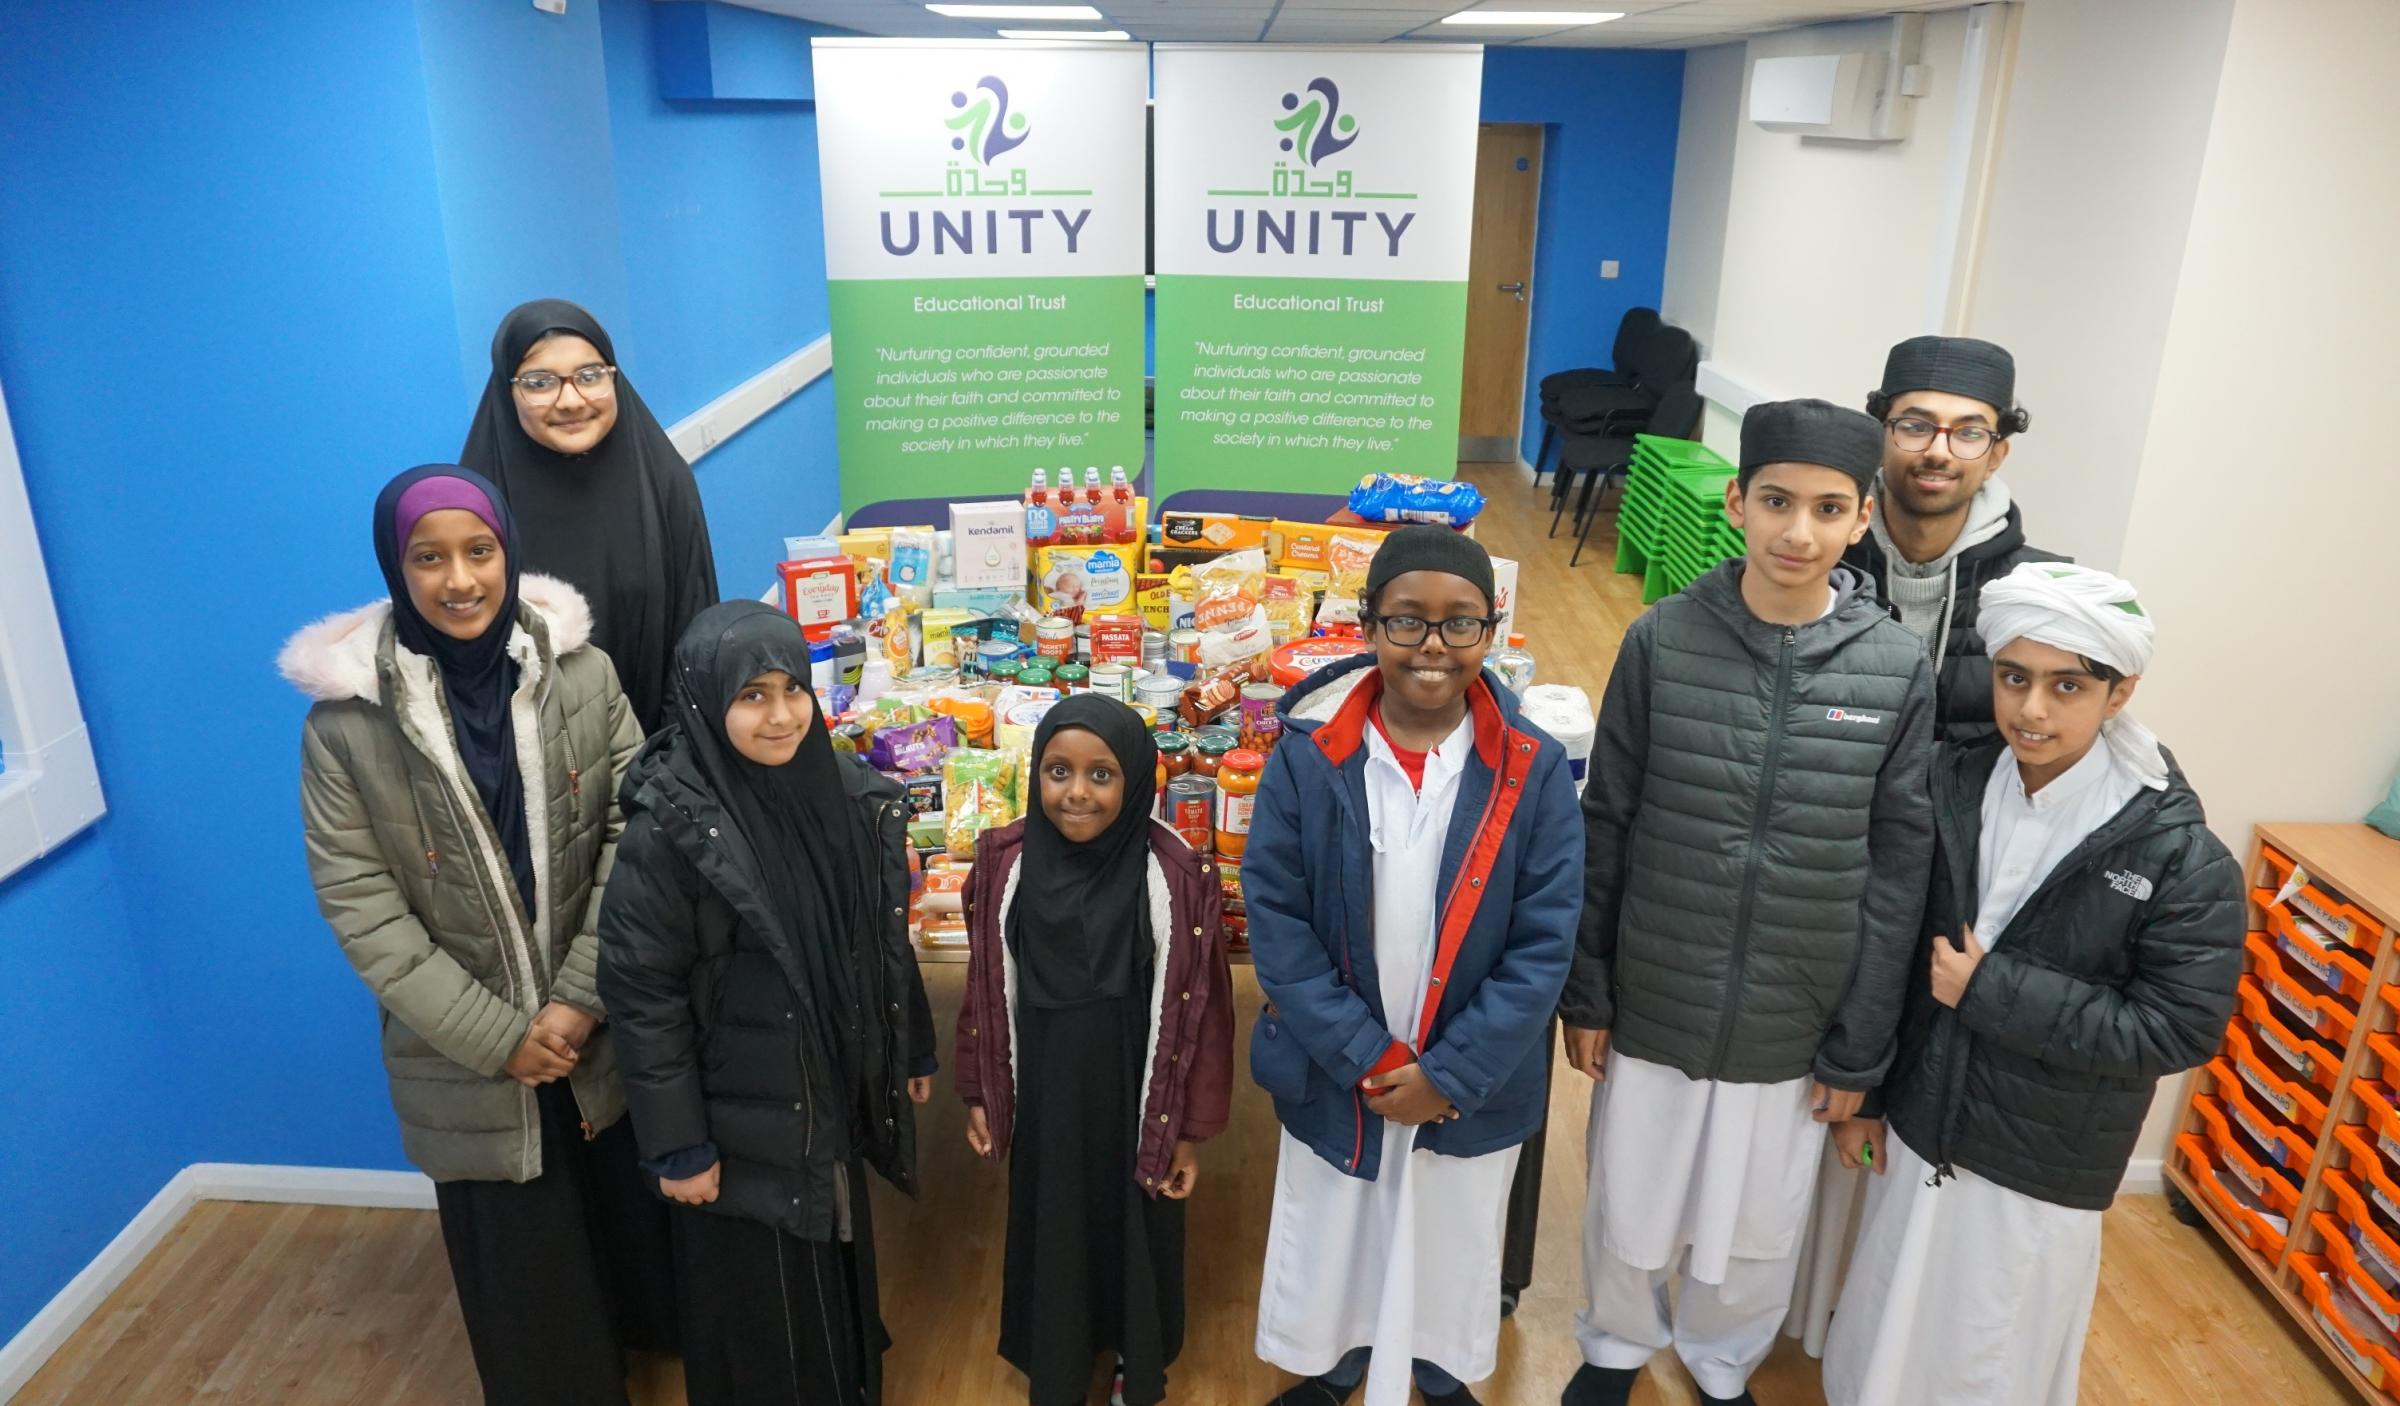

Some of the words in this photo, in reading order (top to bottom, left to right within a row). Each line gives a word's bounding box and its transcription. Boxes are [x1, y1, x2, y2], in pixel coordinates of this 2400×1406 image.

[880, 208, 1092, 257] UNITY
[1206, 208, 1416, 257] UNITY
[914, 295, 1022, 312] Educational
[1028, 294, 1066, 310] Trust
[1234, 294, 1339, 311] Educational
[1346, 297, 1384, 313] Trust
[956, 345, 1030, 360] confident,
[1034, 343, 1109, 360] grounded
[1271, 345, 1344, 359] confident,
[1348, 348, 1425, 363] grounded
[877, 369, 957, 384] individuals
[962, 368, 993, 382] who
[997, 369, 1022, 381] are
[1026, 366, 1107, 382] passionate
[1194, 364, 1272, 380] individuals
[1276, 367, 1307, 380] who
[1311, 370, 1335, 382] are
[1339, 370, 1421, 385] passionate
[864, 393, 911, 408] about
[915, 392, 947, 406] their
[952, 391, 983, 406] faith
[987, 390, 1018, 404] and
[1022, 388, 1103, 402] committed
[1107, 387, 1121, 400] to
[1180, 386, 1225, 399] about
[1229, 387, 1261, 401] their
[1264, 389, 1296, 402] faith
[1300, 390, 1331, 404] and
[1335, 392, 1416, 408] committed
[1420, 395, 1434, 408] to
[866, 416, 923, 432] making
[928, 417, 938, 428] a
[942, 413, 998, 430] positive
[1002, 412, 1075, 426] difference
[1079, 411, 1092, 424] to
[1097, 410, 1120, 423] the
[1181, 409, 1236, 425] making
[1240, 413, 1250, 424] a
[1254, 411, 1309, 426] positive
[1313, 413, 1386, 428] difference
[1390, 416, 1403, 429] to
[1408, 417, 1432, 430] the
[901, 437, 953, 453] society
[958, 436, 970, 449] in
[975, 434, 1019, 449] which
[1023, 433, 1053, 448] they
[1213, 432, 1264, 448] society
[1268, 433, 1280, 446] in
[1285, 434, 1328, 448] which
[1332, 436, 1364, 452] they
[968, 526, 1014, 536] Kendamil
[1291, 543, 1320, 552] Custard
[1291, 550, 1319, 559] Creams
[1088, 556, 1120, 569] mamia
[803, 583, 840, 596] Everyday
[1144, 605, 1169, 613] ENCH
[1198, 601, 1246, 623] PENNE
[930, 627, 950, 640] mami
[1220, 866, 1240, 876] HEIN
[2104, 870, 2139, 890] NORTH
[2123, 869, 2142, 882] THE
[2110, 881, 2136, 897] FACE
